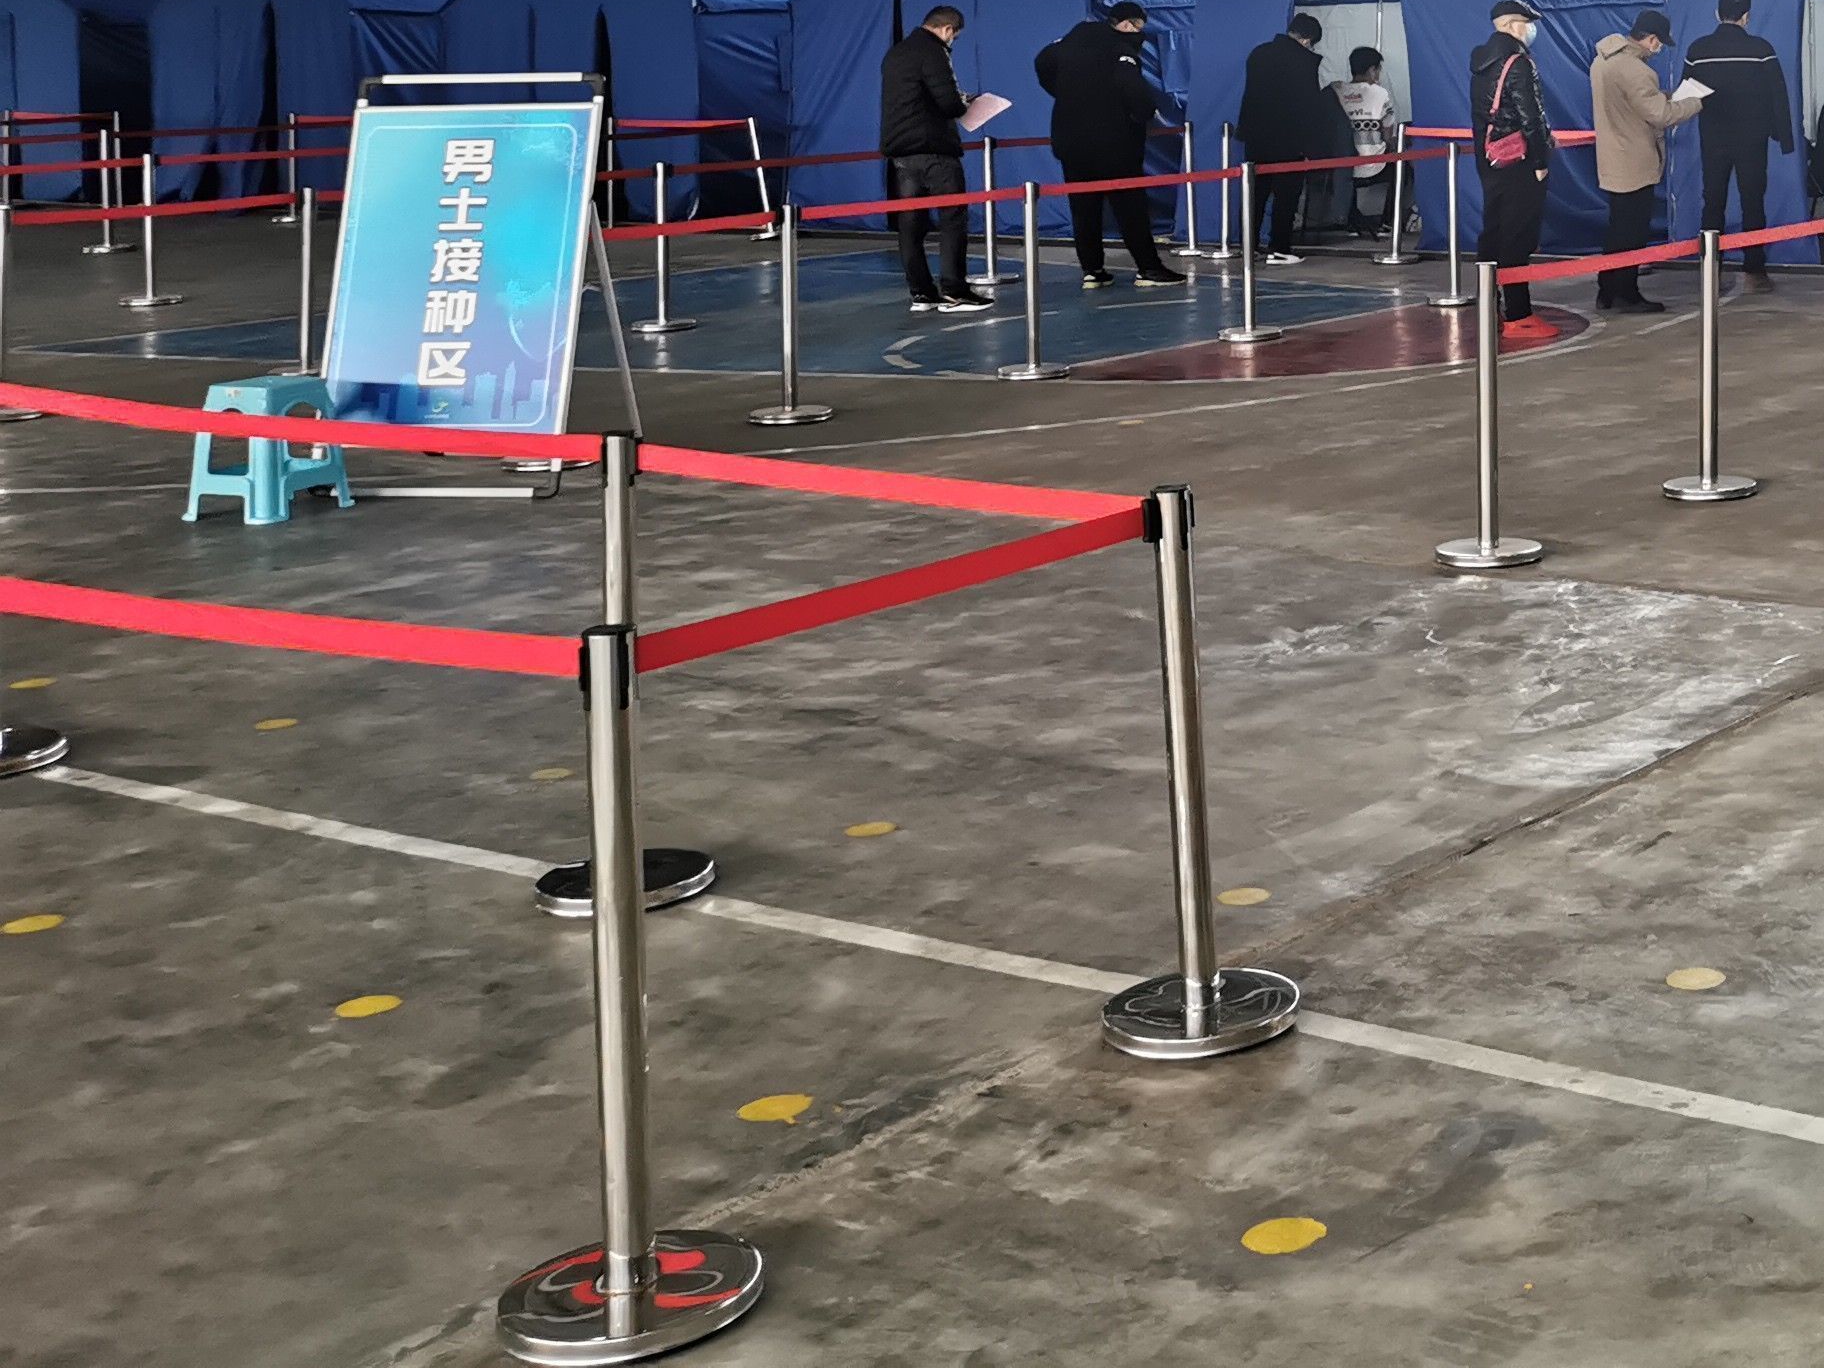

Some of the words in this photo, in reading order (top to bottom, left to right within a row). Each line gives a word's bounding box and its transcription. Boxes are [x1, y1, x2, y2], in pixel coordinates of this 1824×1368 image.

[417, 138, 495, 386] 男士接种区
